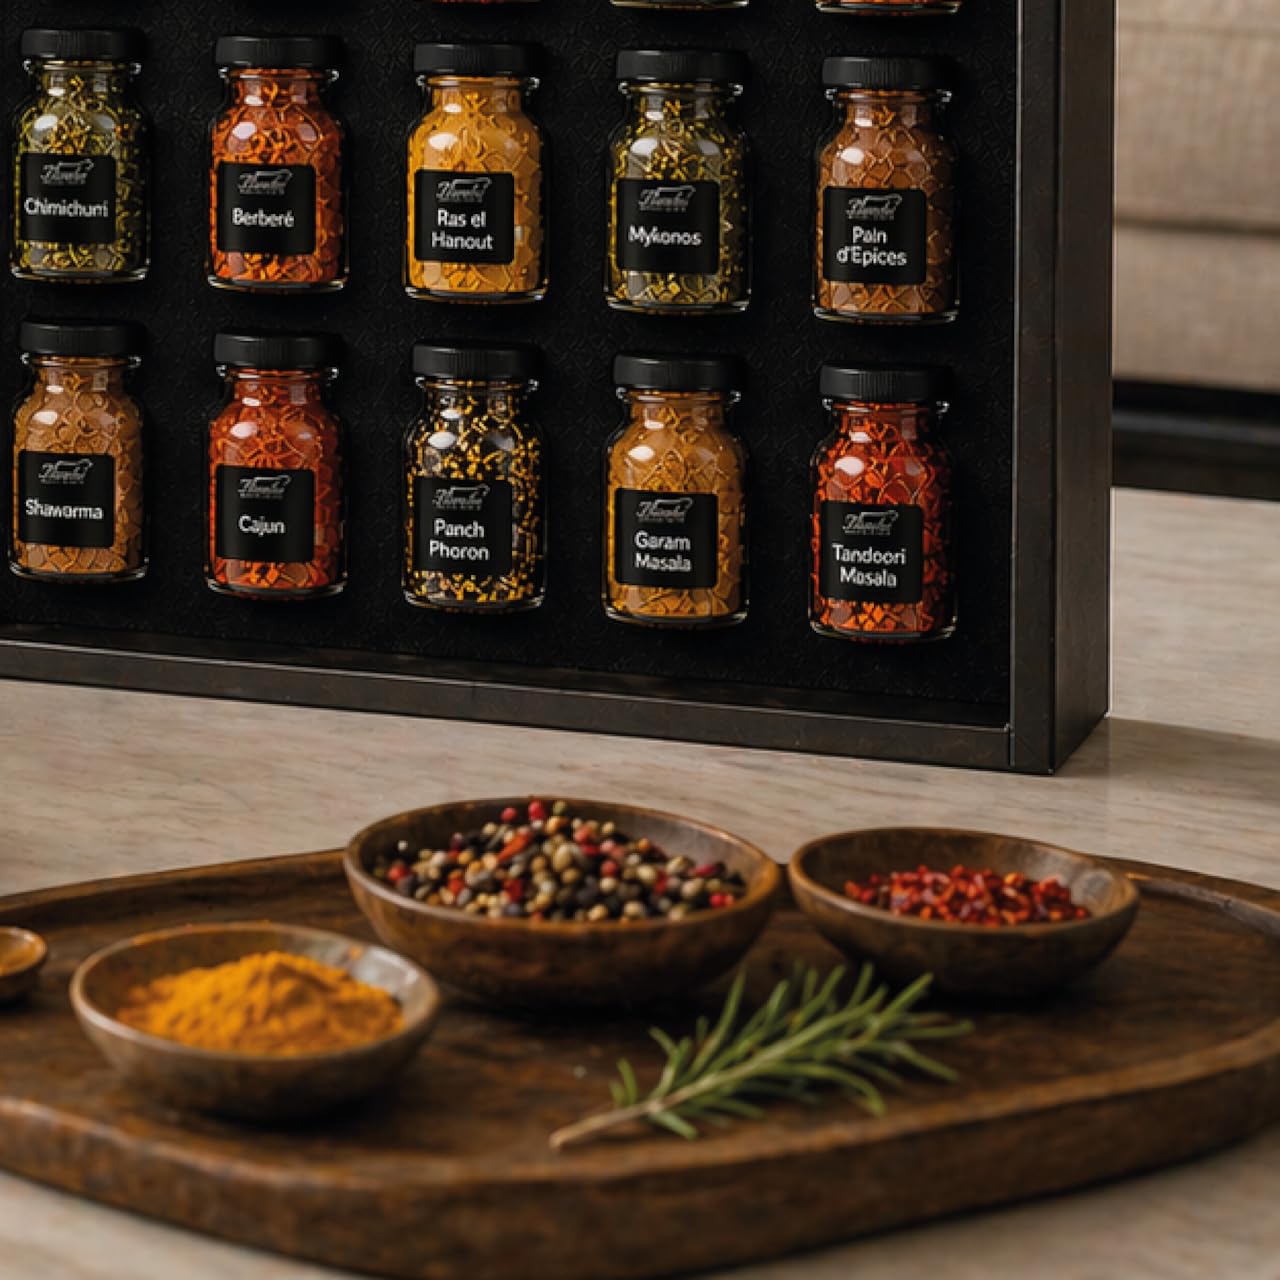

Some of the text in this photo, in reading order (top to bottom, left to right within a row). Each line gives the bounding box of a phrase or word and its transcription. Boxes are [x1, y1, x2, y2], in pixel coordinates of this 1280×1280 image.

[437, 207, 487, 228] Ras el
[431, 231, 493, 250] Hanout
[628, 225, 702, 248] Mykonos
[852, 225, 887, 244] Pain
[25, 498, 103, 520] Shawarma
[238, 515, 285, 536] Cajun
[433, 517, 485, 538] Panch
[429, 539, 489, 561] Phoron
[634, 530, 691, 550] Garam
[635, 552, 691, 572] Masala
[831, 542, 906, 565] Tandoori
[840, 566, 897, 587] Masala
